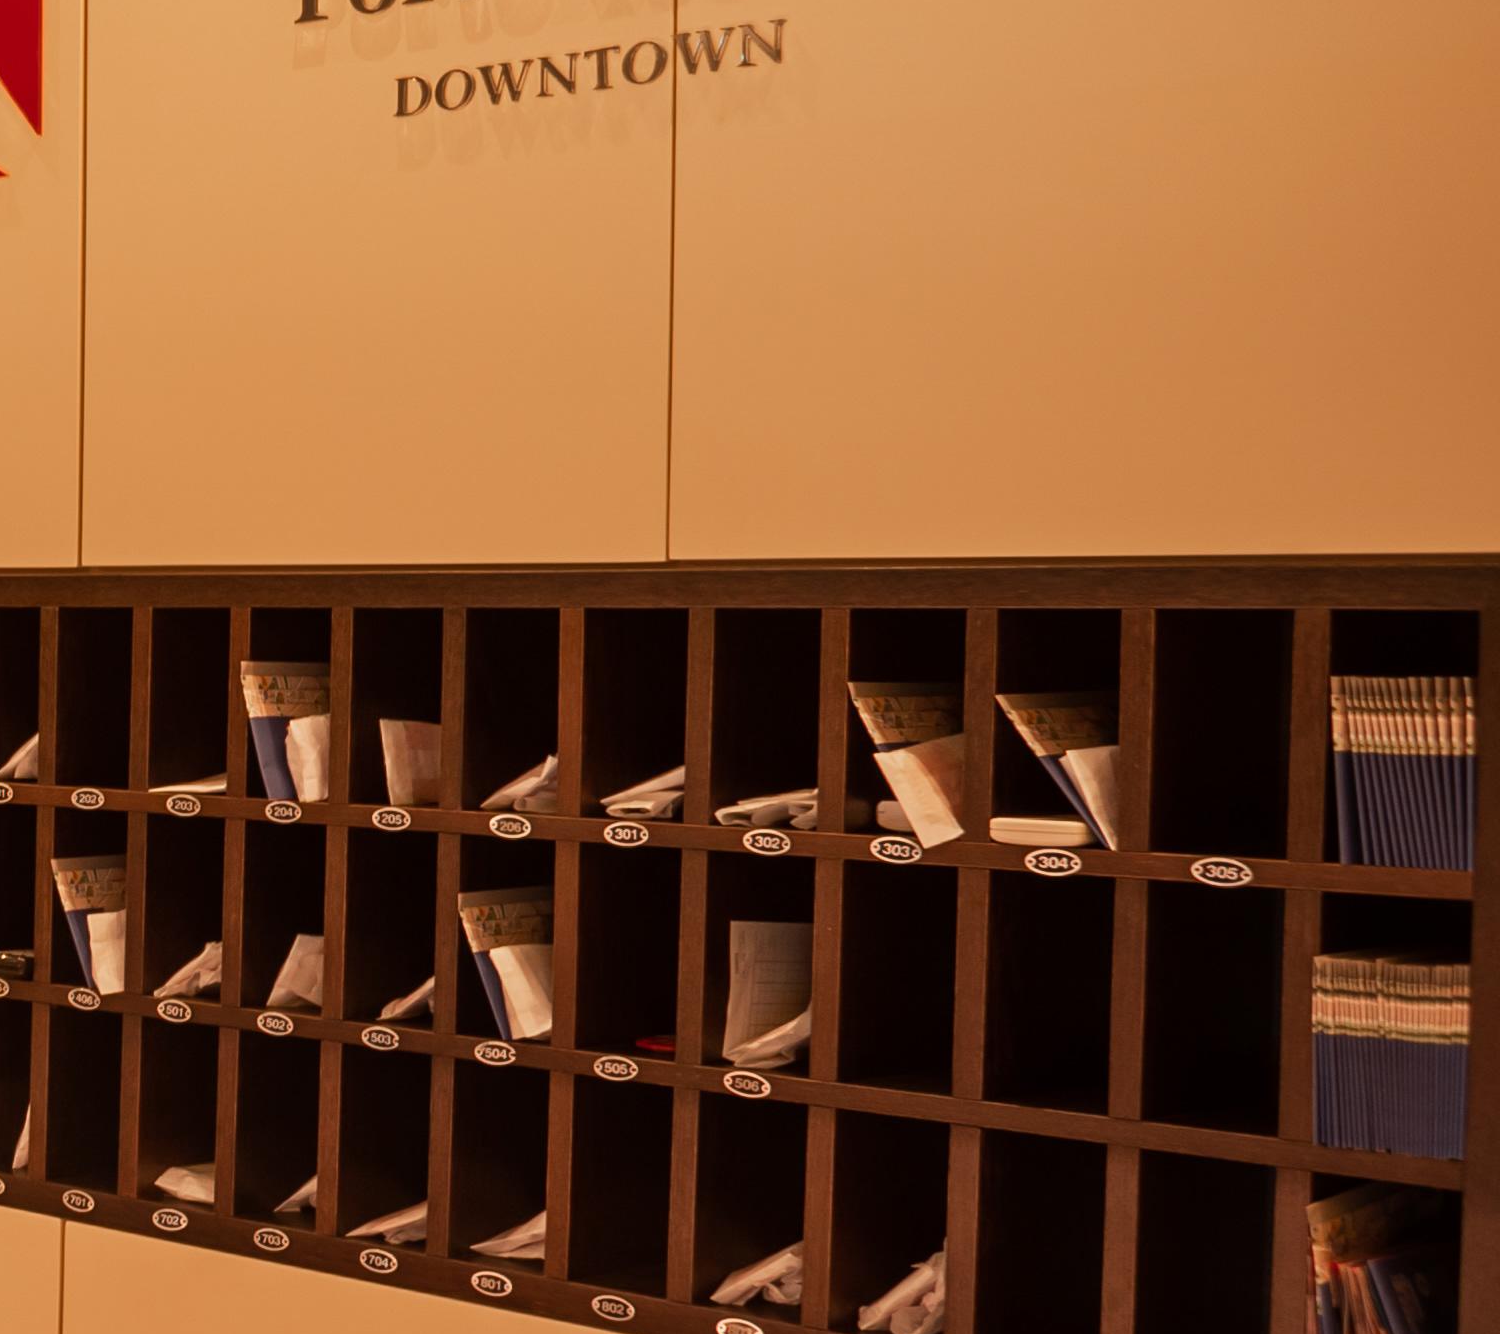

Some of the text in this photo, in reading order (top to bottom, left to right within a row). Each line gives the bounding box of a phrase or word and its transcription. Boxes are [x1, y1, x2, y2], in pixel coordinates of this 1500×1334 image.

[392, 18, 788, 119] DOWNTOWN
[174, 800, 193, 812] 203
[273, 807, 293, 817] 204
[381, 814, 402, 825] 205
[500, 820, 522, 833] 206
[614, 828, 638, 841] 301
[753, 835, 781, 850] 302
[881, 841, 911, 858] 303
[1037, 855, 1069, 869] 304
[1205, 865, 1239, 881] 305
[165, 1005, 185, 1017] 501
[265, 1018, 285, 1031] 502
[370, 1032, 392, 1045] 503
[484, 1047, 508, 1060] 504
[604, 1062, 628, 1075] 505
[734, 1077, 760, 1092] 506
[69, 1195, 87, 1208] 701
[160, 1213, 180, 1226] 702
[261, 1233, 282, 1246] 703
[367, 1254, 390, 1269] 704
[480, 1277, 502, 1291] 801
[601, 1300, 625, 1315] 802
